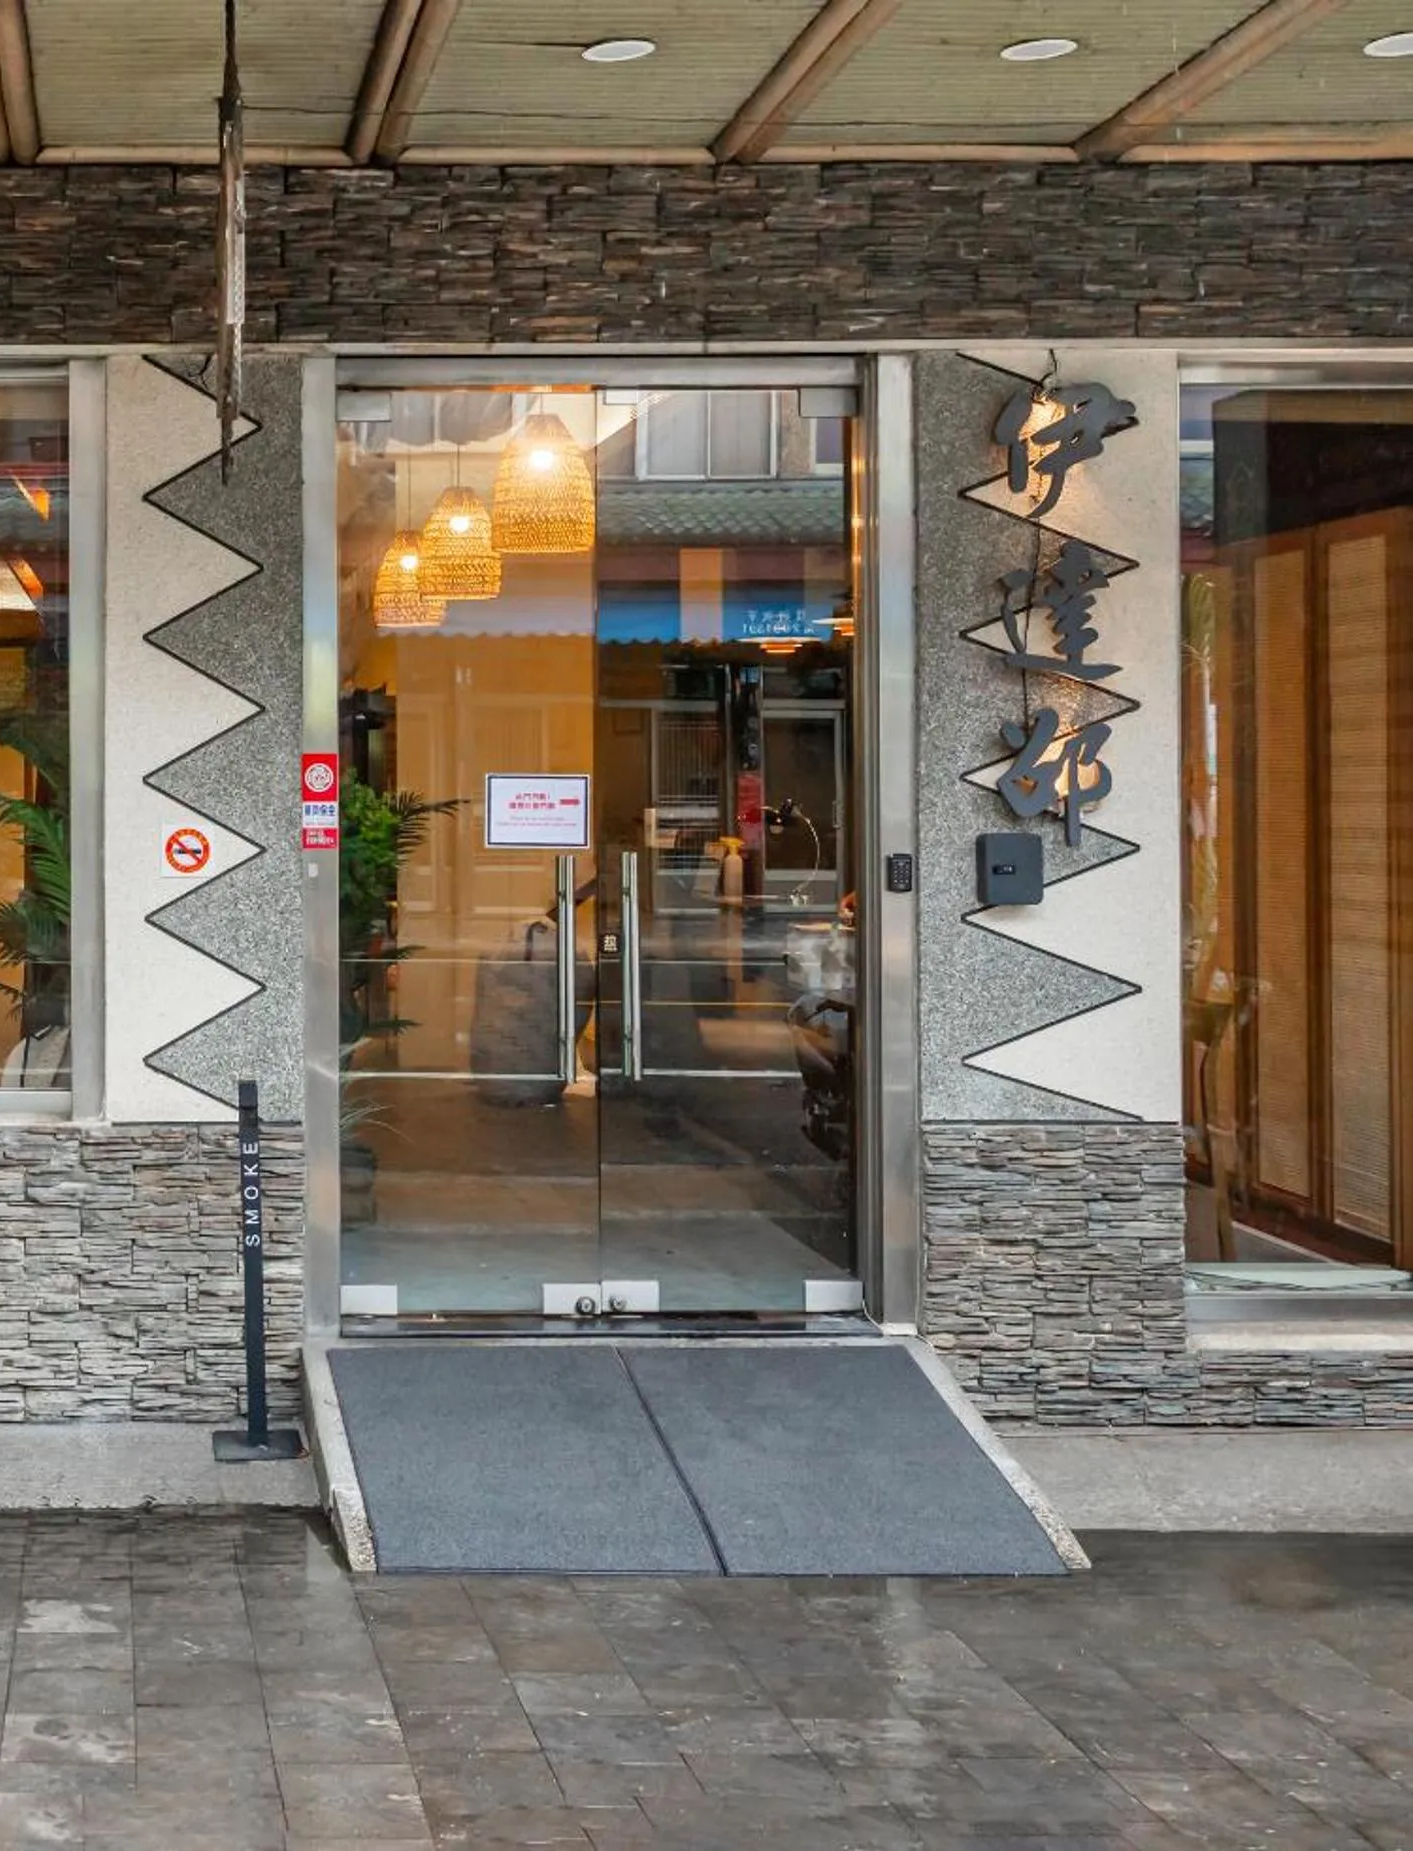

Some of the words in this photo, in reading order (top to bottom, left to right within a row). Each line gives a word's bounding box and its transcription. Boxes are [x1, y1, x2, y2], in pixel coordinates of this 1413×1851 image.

[992, 382, 1139, 847] 伊達邵
[243, 1142, 260, 1247] SMOKE
